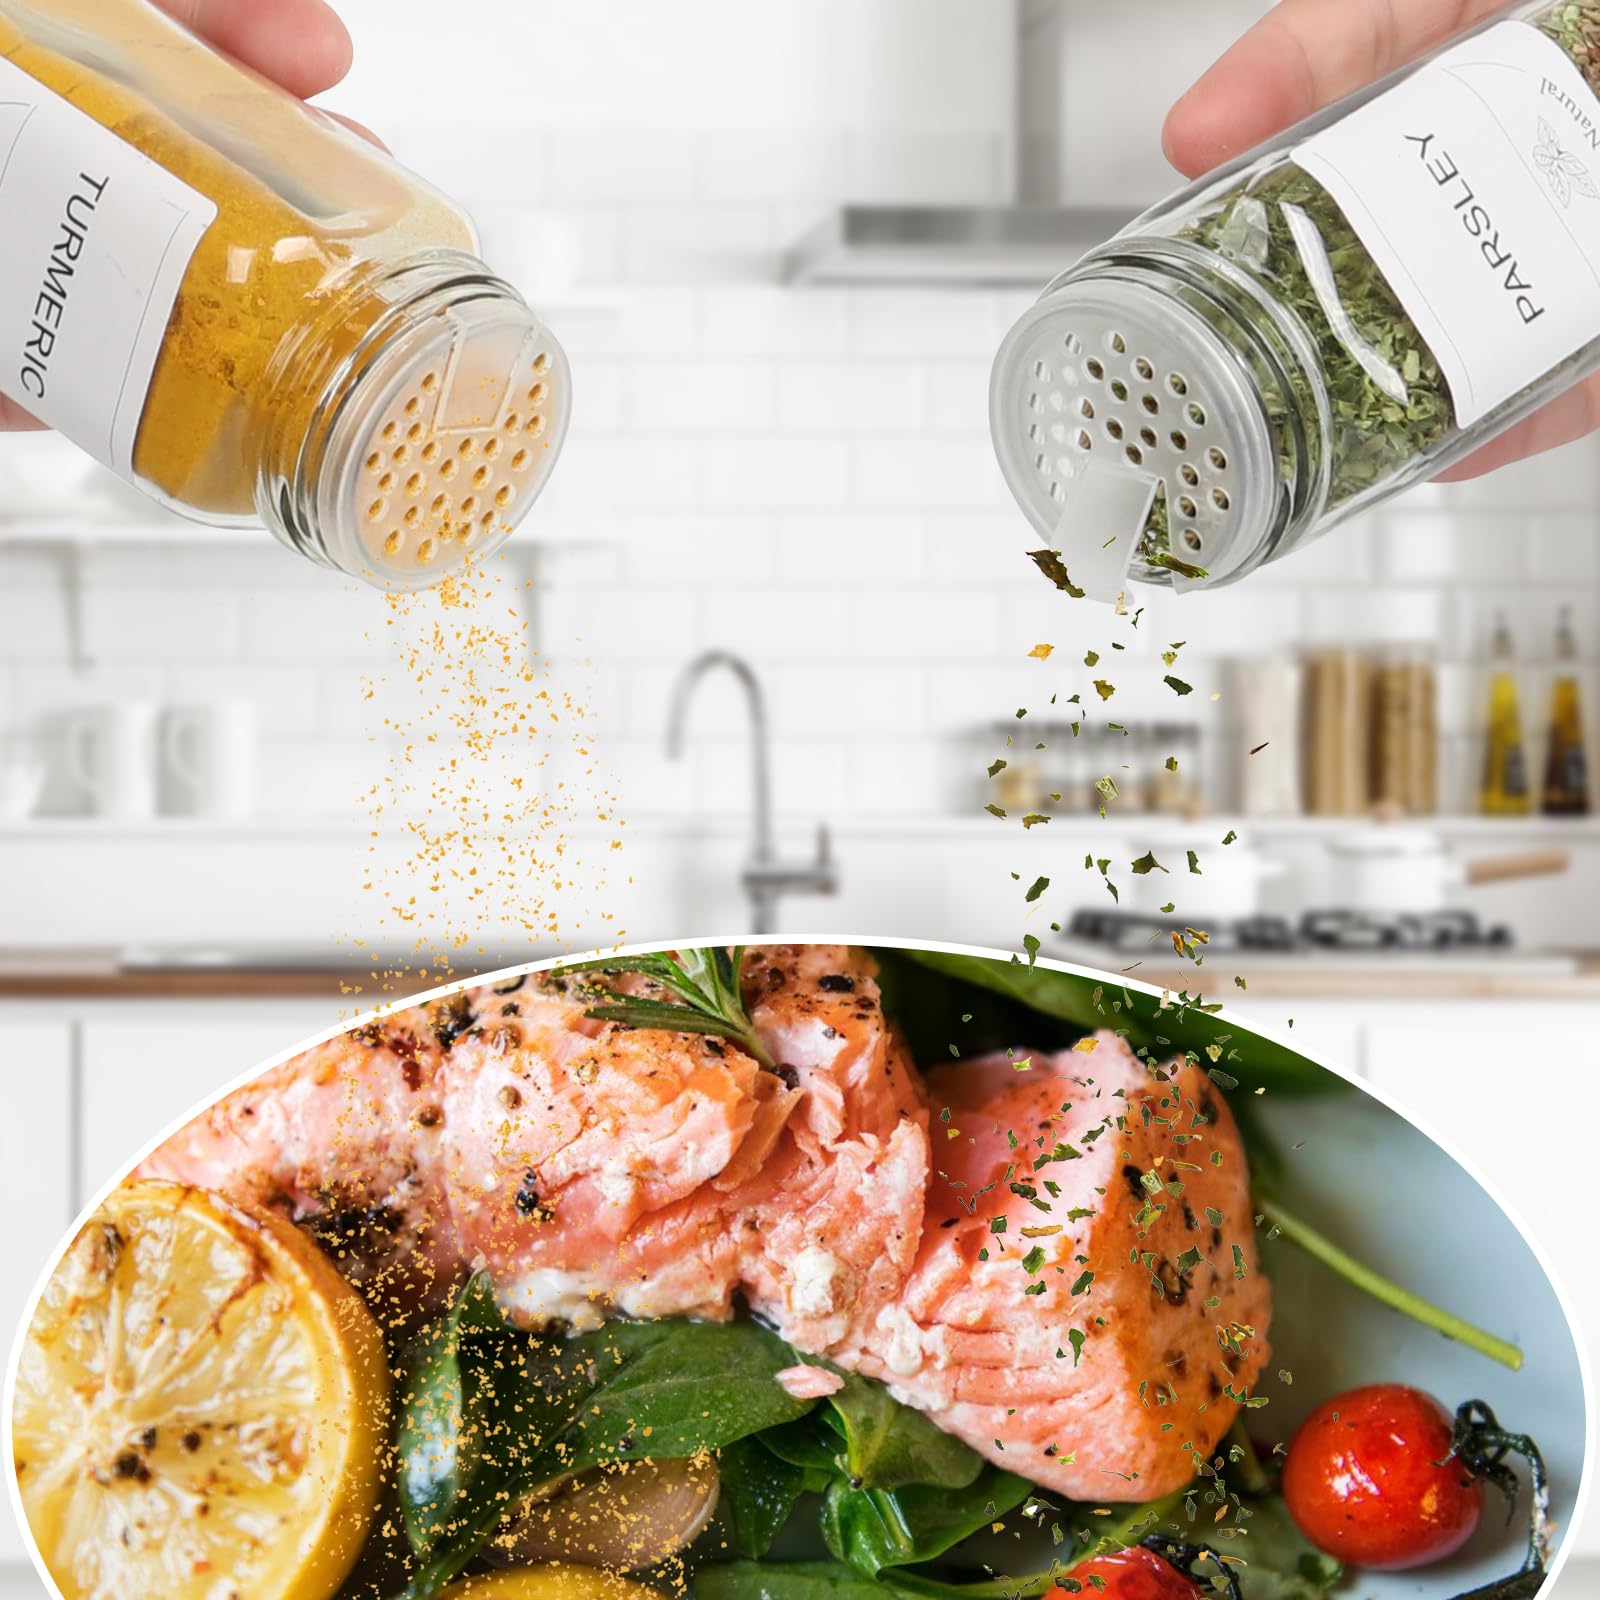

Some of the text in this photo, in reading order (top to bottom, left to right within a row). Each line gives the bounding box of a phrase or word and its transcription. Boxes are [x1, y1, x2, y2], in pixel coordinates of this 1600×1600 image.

[1539, 77, 1600, 150] Natural
[20, 171, 110, 399] TURMERIC
[1403, 131, 1545, 325] PARSLEY
